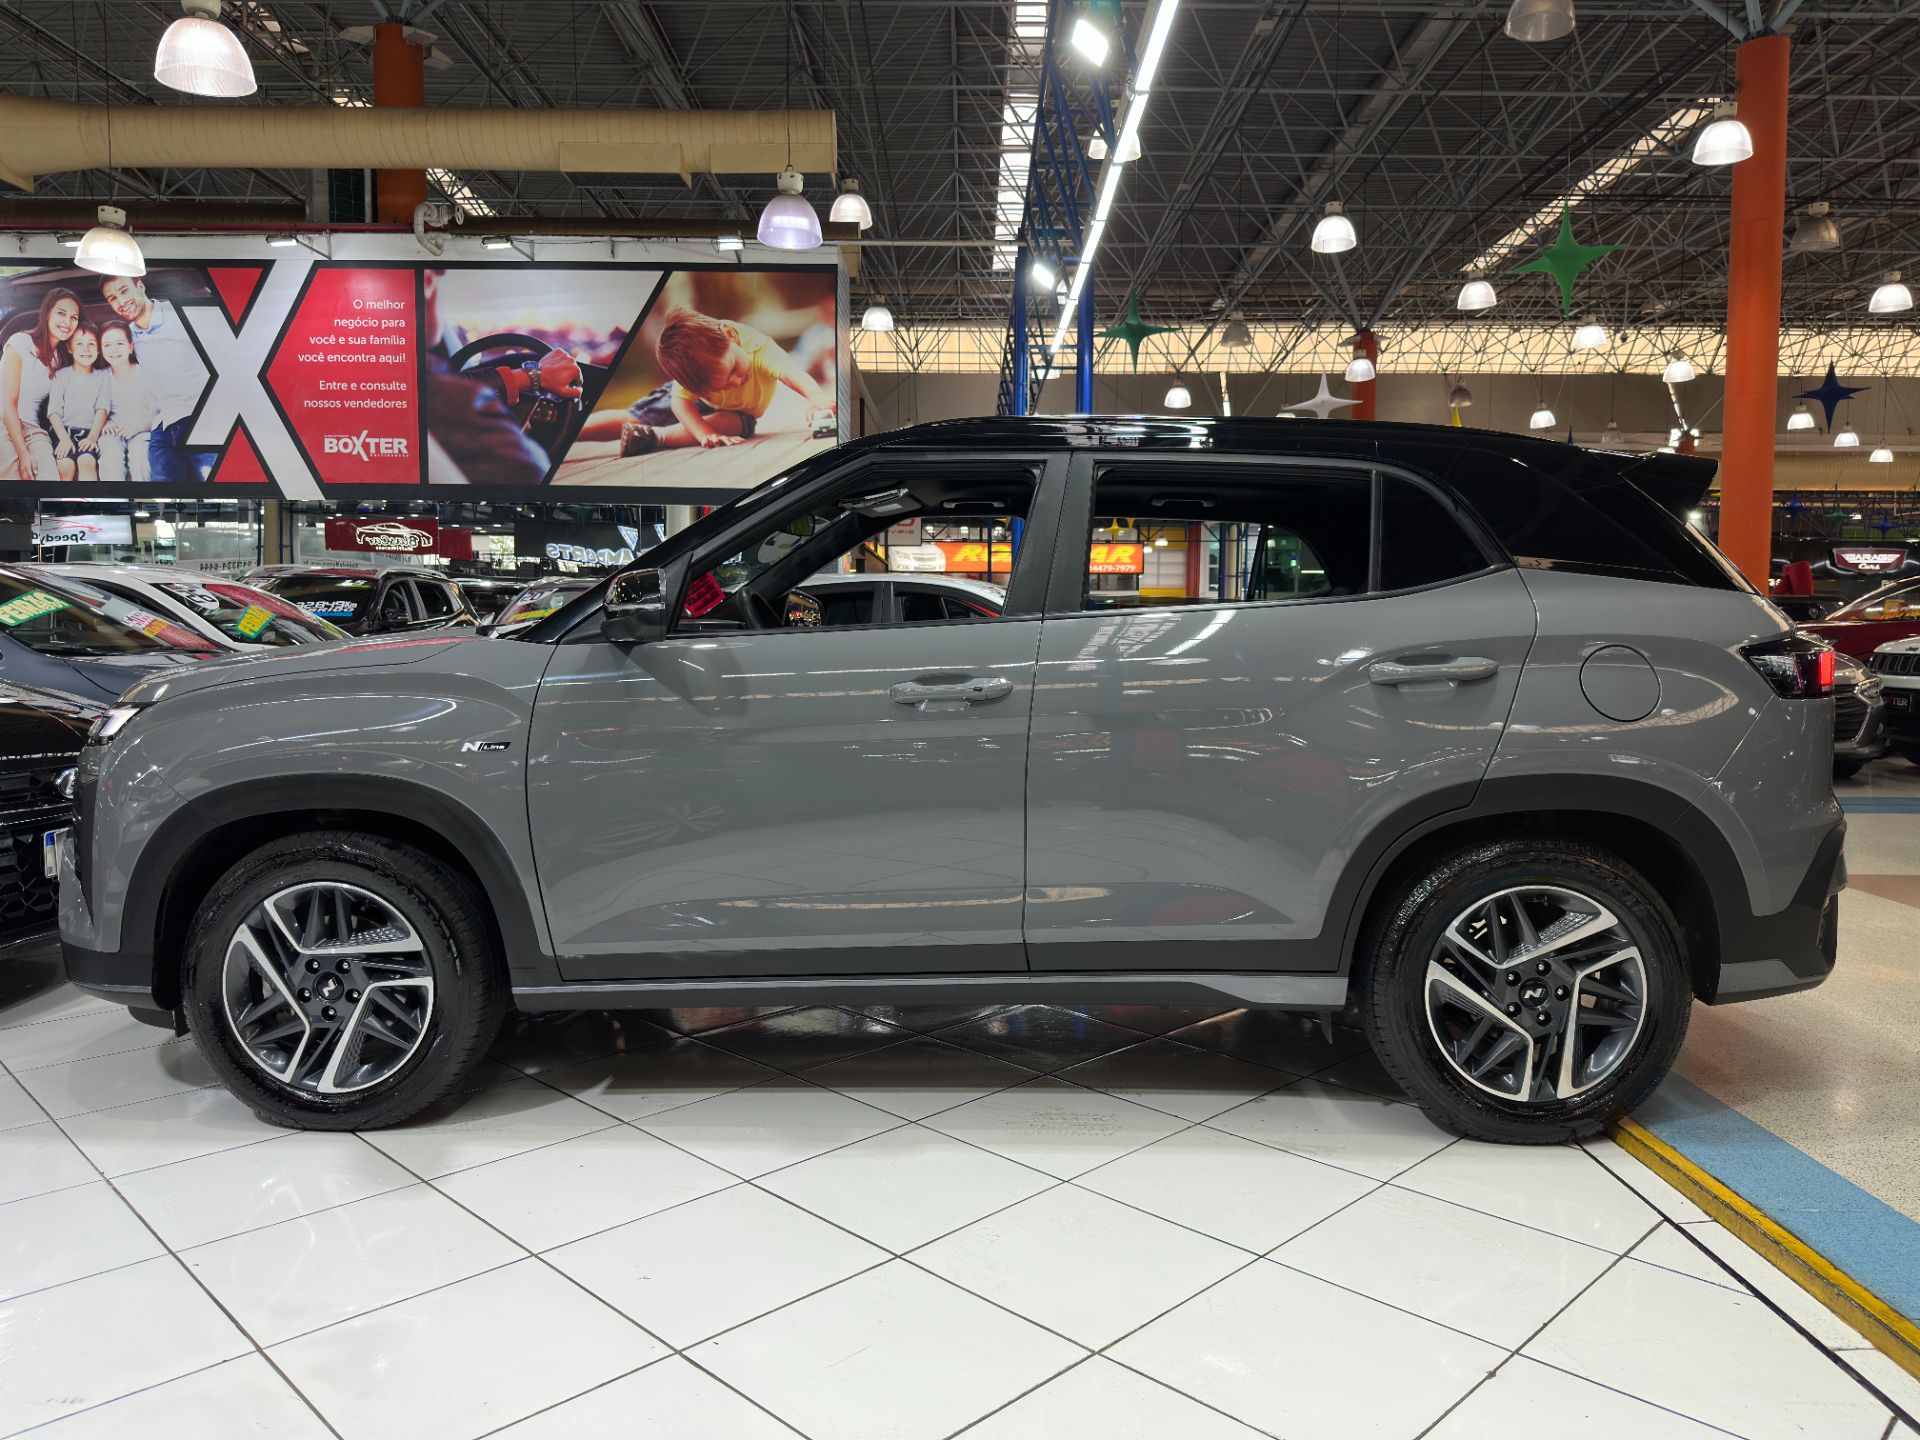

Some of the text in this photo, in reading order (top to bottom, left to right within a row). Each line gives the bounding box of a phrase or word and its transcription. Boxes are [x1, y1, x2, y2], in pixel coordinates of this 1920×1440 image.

[353, 299, 405, 310] O melhor
[334, 317, 405, 330] negócio para
[309, 335, 406, 345] você e sua família
[298, 352, 406, 365] você encontra aqui!
[319, 381, 407, 391] Entre e consulte
[304, 399, 408, 409] nossos vendedores
[324, 430, 408, 462] BOXTER
